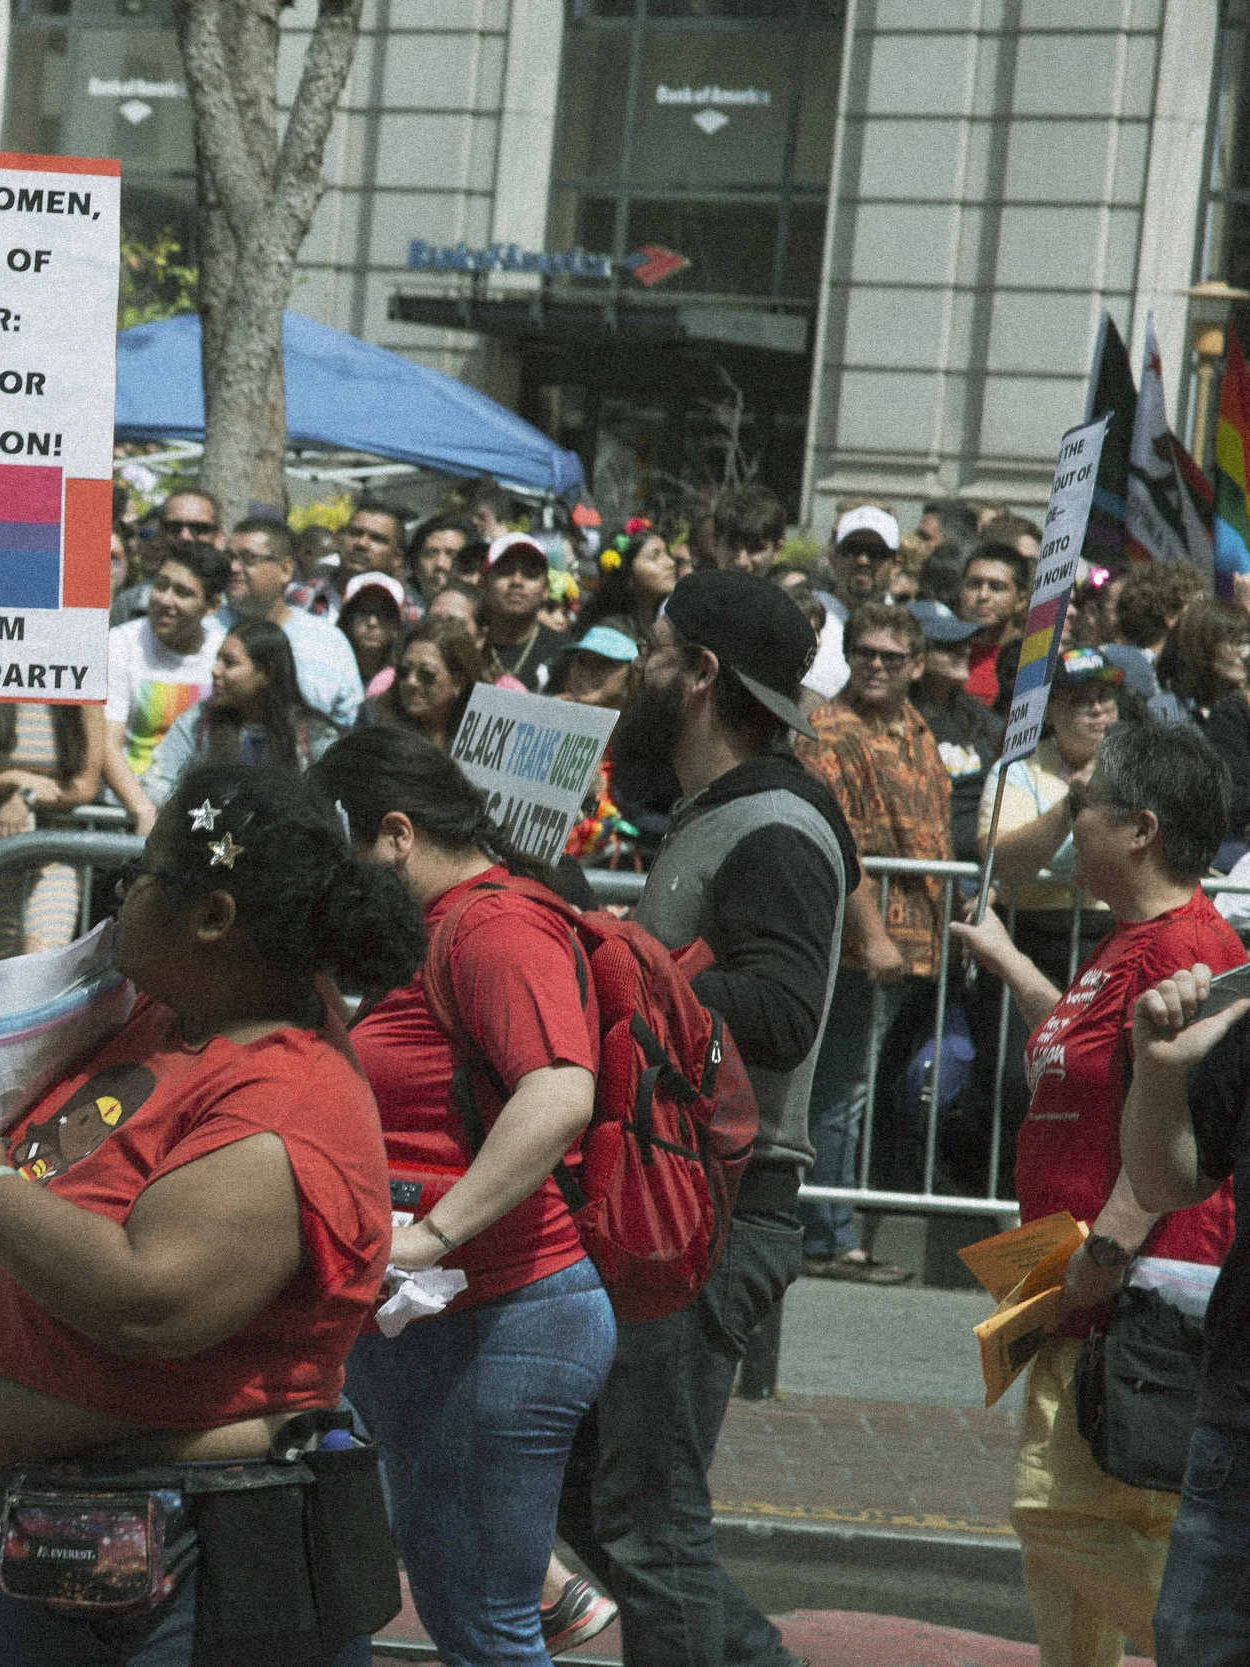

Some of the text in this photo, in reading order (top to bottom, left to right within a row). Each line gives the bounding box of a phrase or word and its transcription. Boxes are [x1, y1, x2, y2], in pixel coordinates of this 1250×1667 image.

[7, 249, 52, 273] OF
[1077, 463, 1093, 482] OF
[1043, 561, 1074, 586] NOW!
[453, 710, 599, 794] BLACK TRANS QUEER
